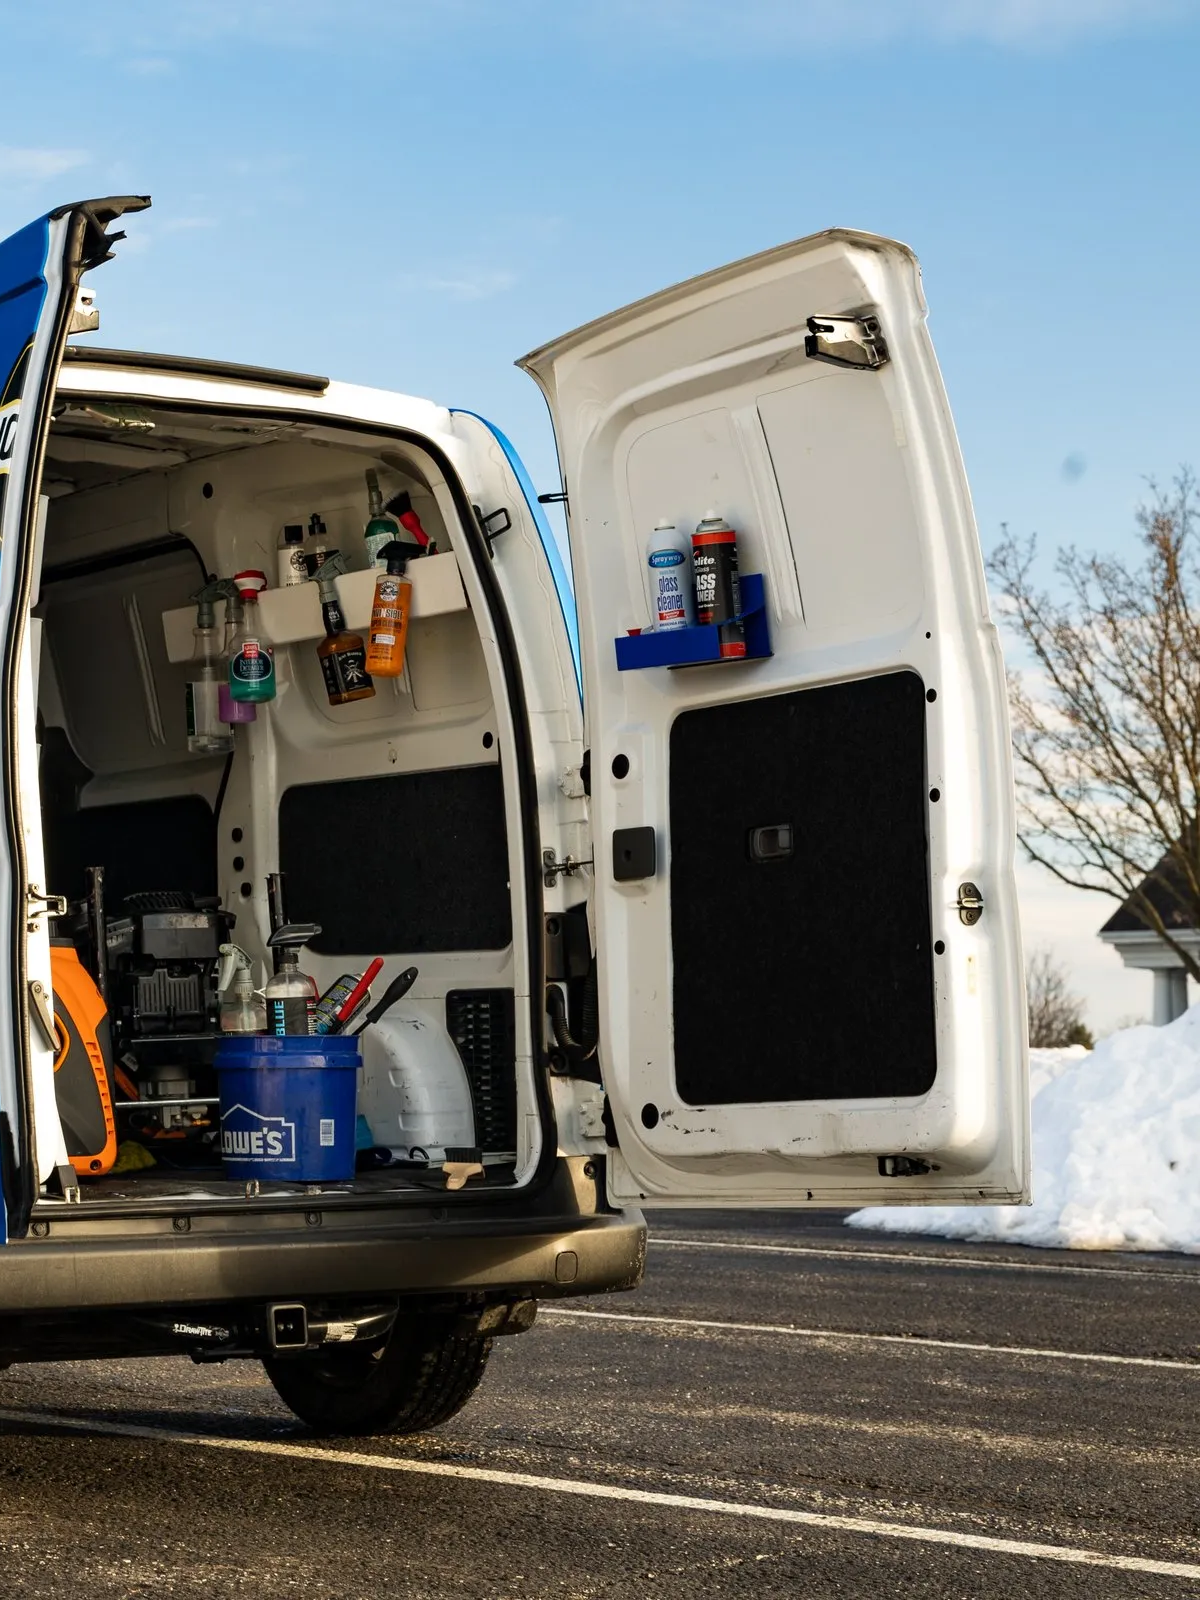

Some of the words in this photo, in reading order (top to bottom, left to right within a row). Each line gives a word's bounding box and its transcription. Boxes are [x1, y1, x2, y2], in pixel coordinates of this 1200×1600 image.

[652, 554, 682, 565] Sprayway
[659, 576, 678, 595] glass
[657, 594, 683, 611] cleaner
[274, 1000, 286, 1037] BLUE
